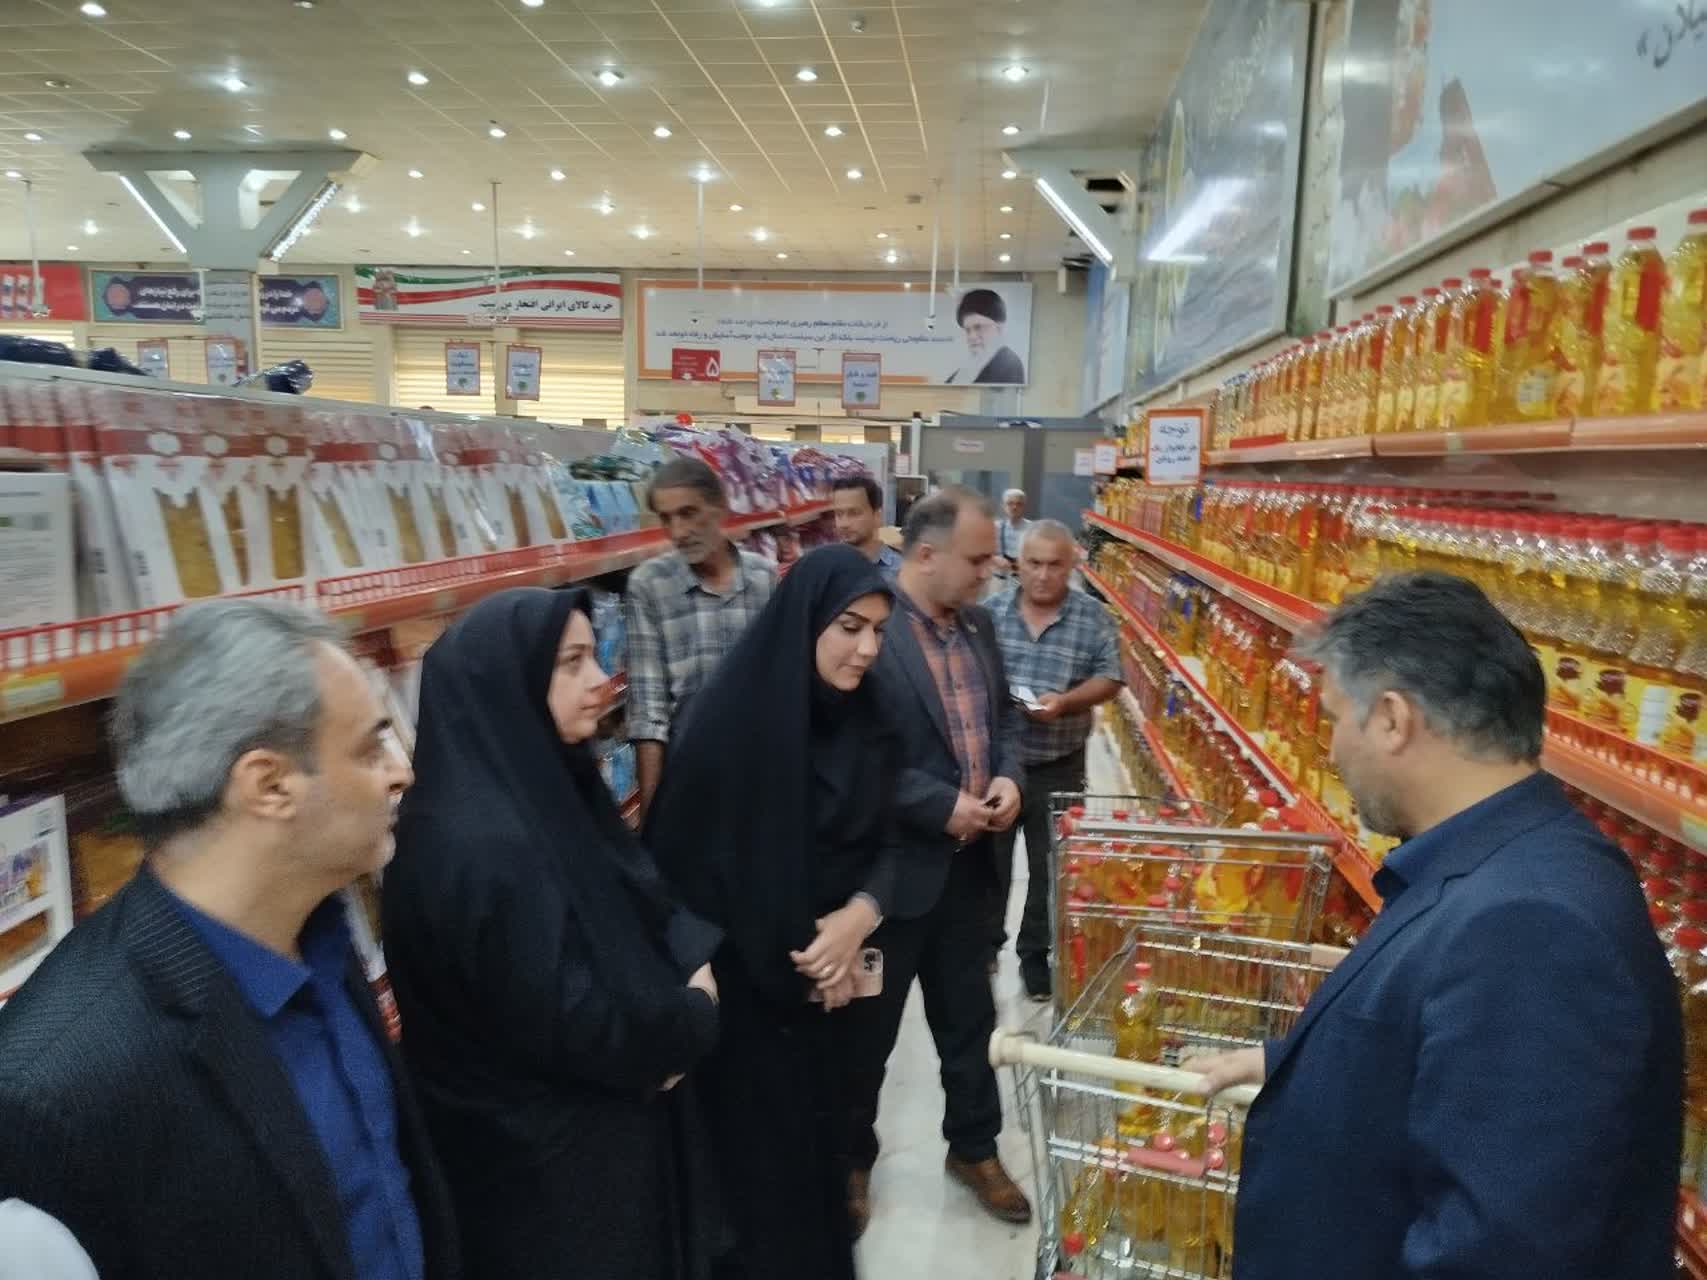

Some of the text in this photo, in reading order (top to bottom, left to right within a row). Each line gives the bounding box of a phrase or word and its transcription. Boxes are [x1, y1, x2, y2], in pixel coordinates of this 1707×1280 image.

[514, 300, 538, 310] افتخار
[540, 300, 566, 312] ایرانی
[567, 300, 590, 312] کالای
[592, 300, 613, 312] خرید
[1158, 422, 1191, 438] توجه
